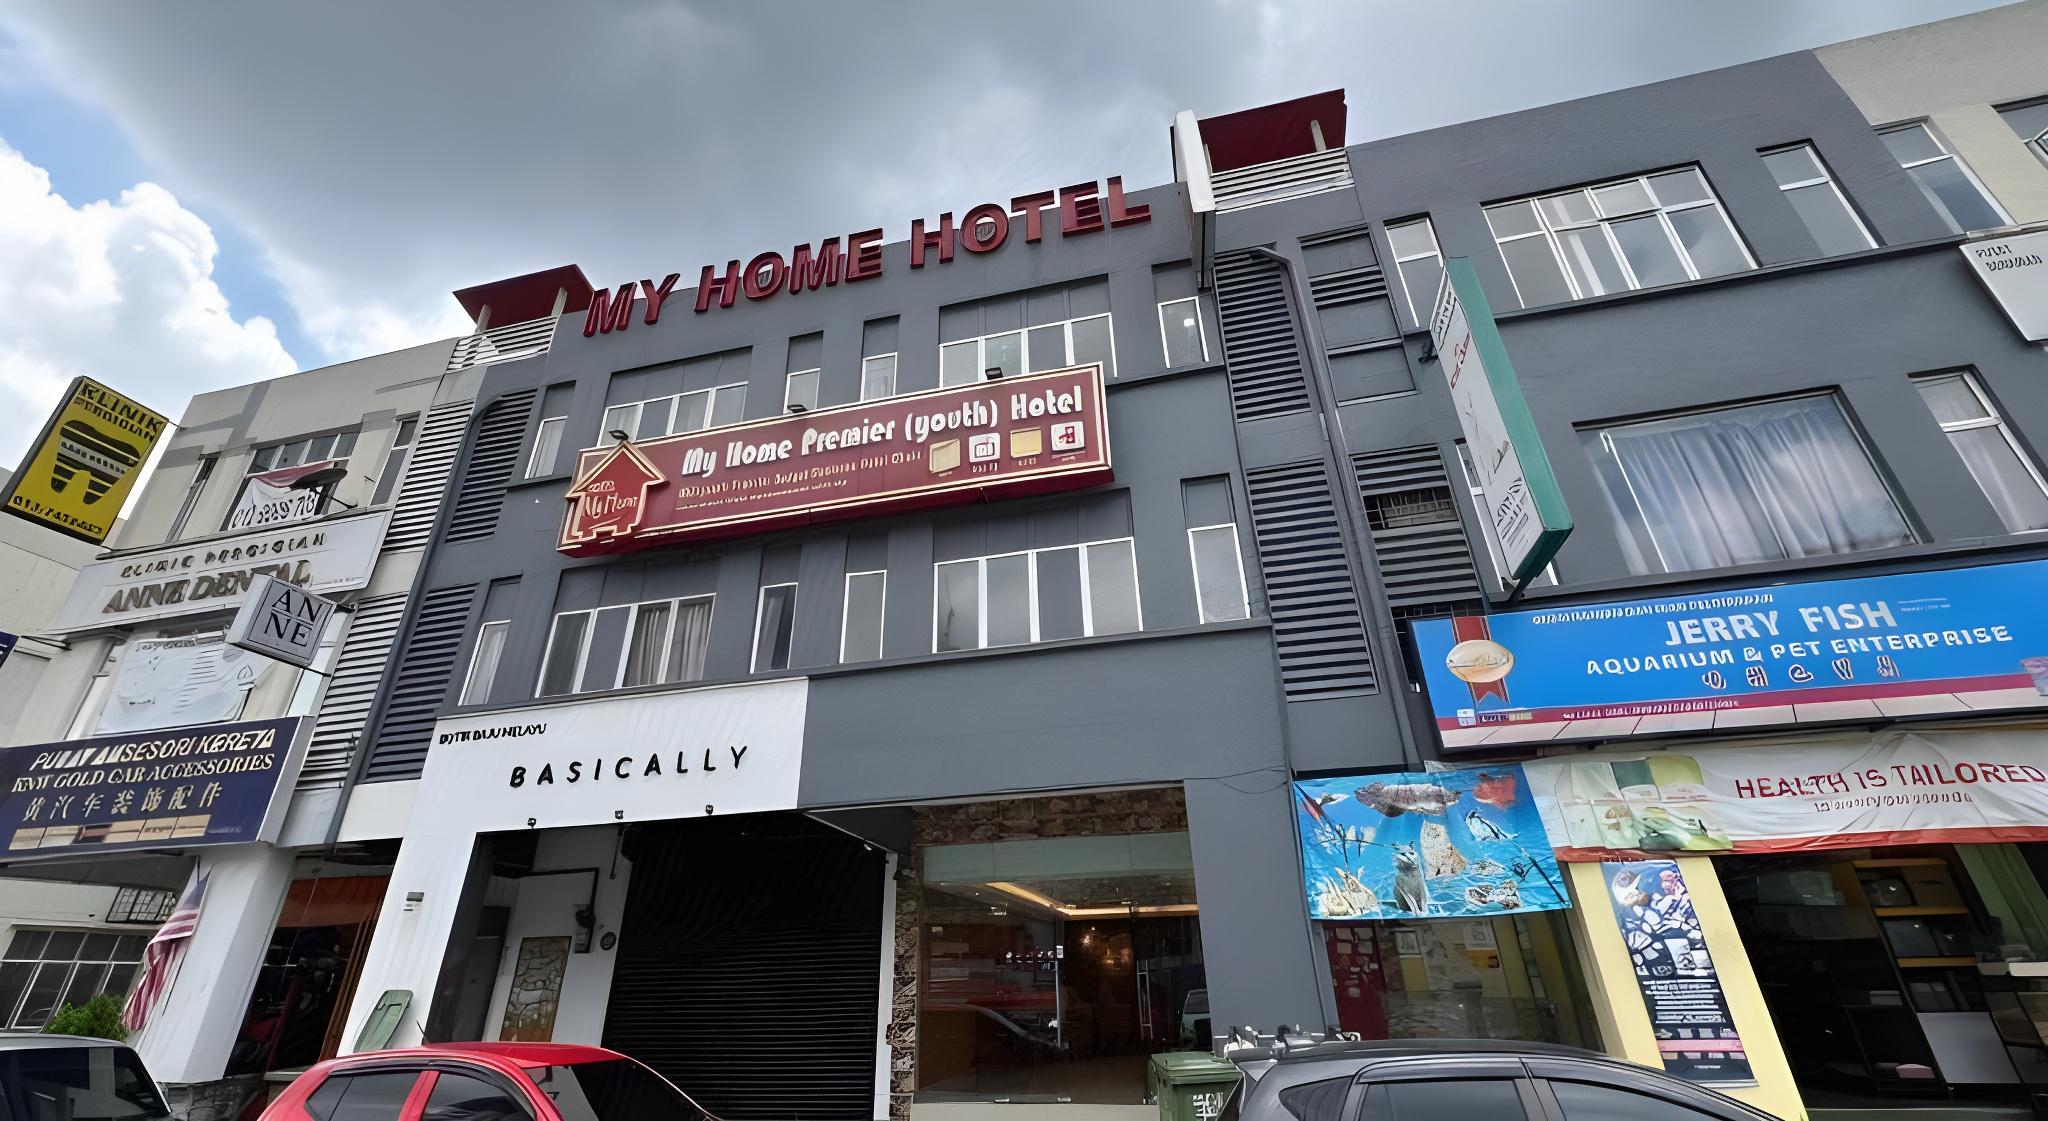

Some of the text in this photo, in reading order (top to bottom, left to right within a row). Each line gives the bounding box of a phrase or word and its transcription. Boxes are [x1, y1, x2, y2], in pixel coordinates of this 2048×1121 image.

[583, 175, 1151, 337] MY HOME HOTEL
[682, 447, 717, 478] My
[726, 439, 792, 467] Home
[801, 418, 895, 456] Premier
[905, 400, 998, 443] (youth)
[1011, 385, 1082, 420] Hotel
[271, 587, 323, 622] AN
[1665, 610, 1779, 646] JERRY
[1798, 600, 1898, 633] FISH
[264, 613, 313, 647] NE
[1586, 649, 1734, 676] AQUARIUM
[1770, 640, 1821, 659] PET
[1831, 625, 2013, 655] ENTERPRISE
[54, 770, 104, 788] GOLD
[146, 753, 274, 781] ACCESSORIES
[509, 745, 747, 788] BASICALLY
[1734, 762, 2047, 800] HEALTH IS TAILORED
